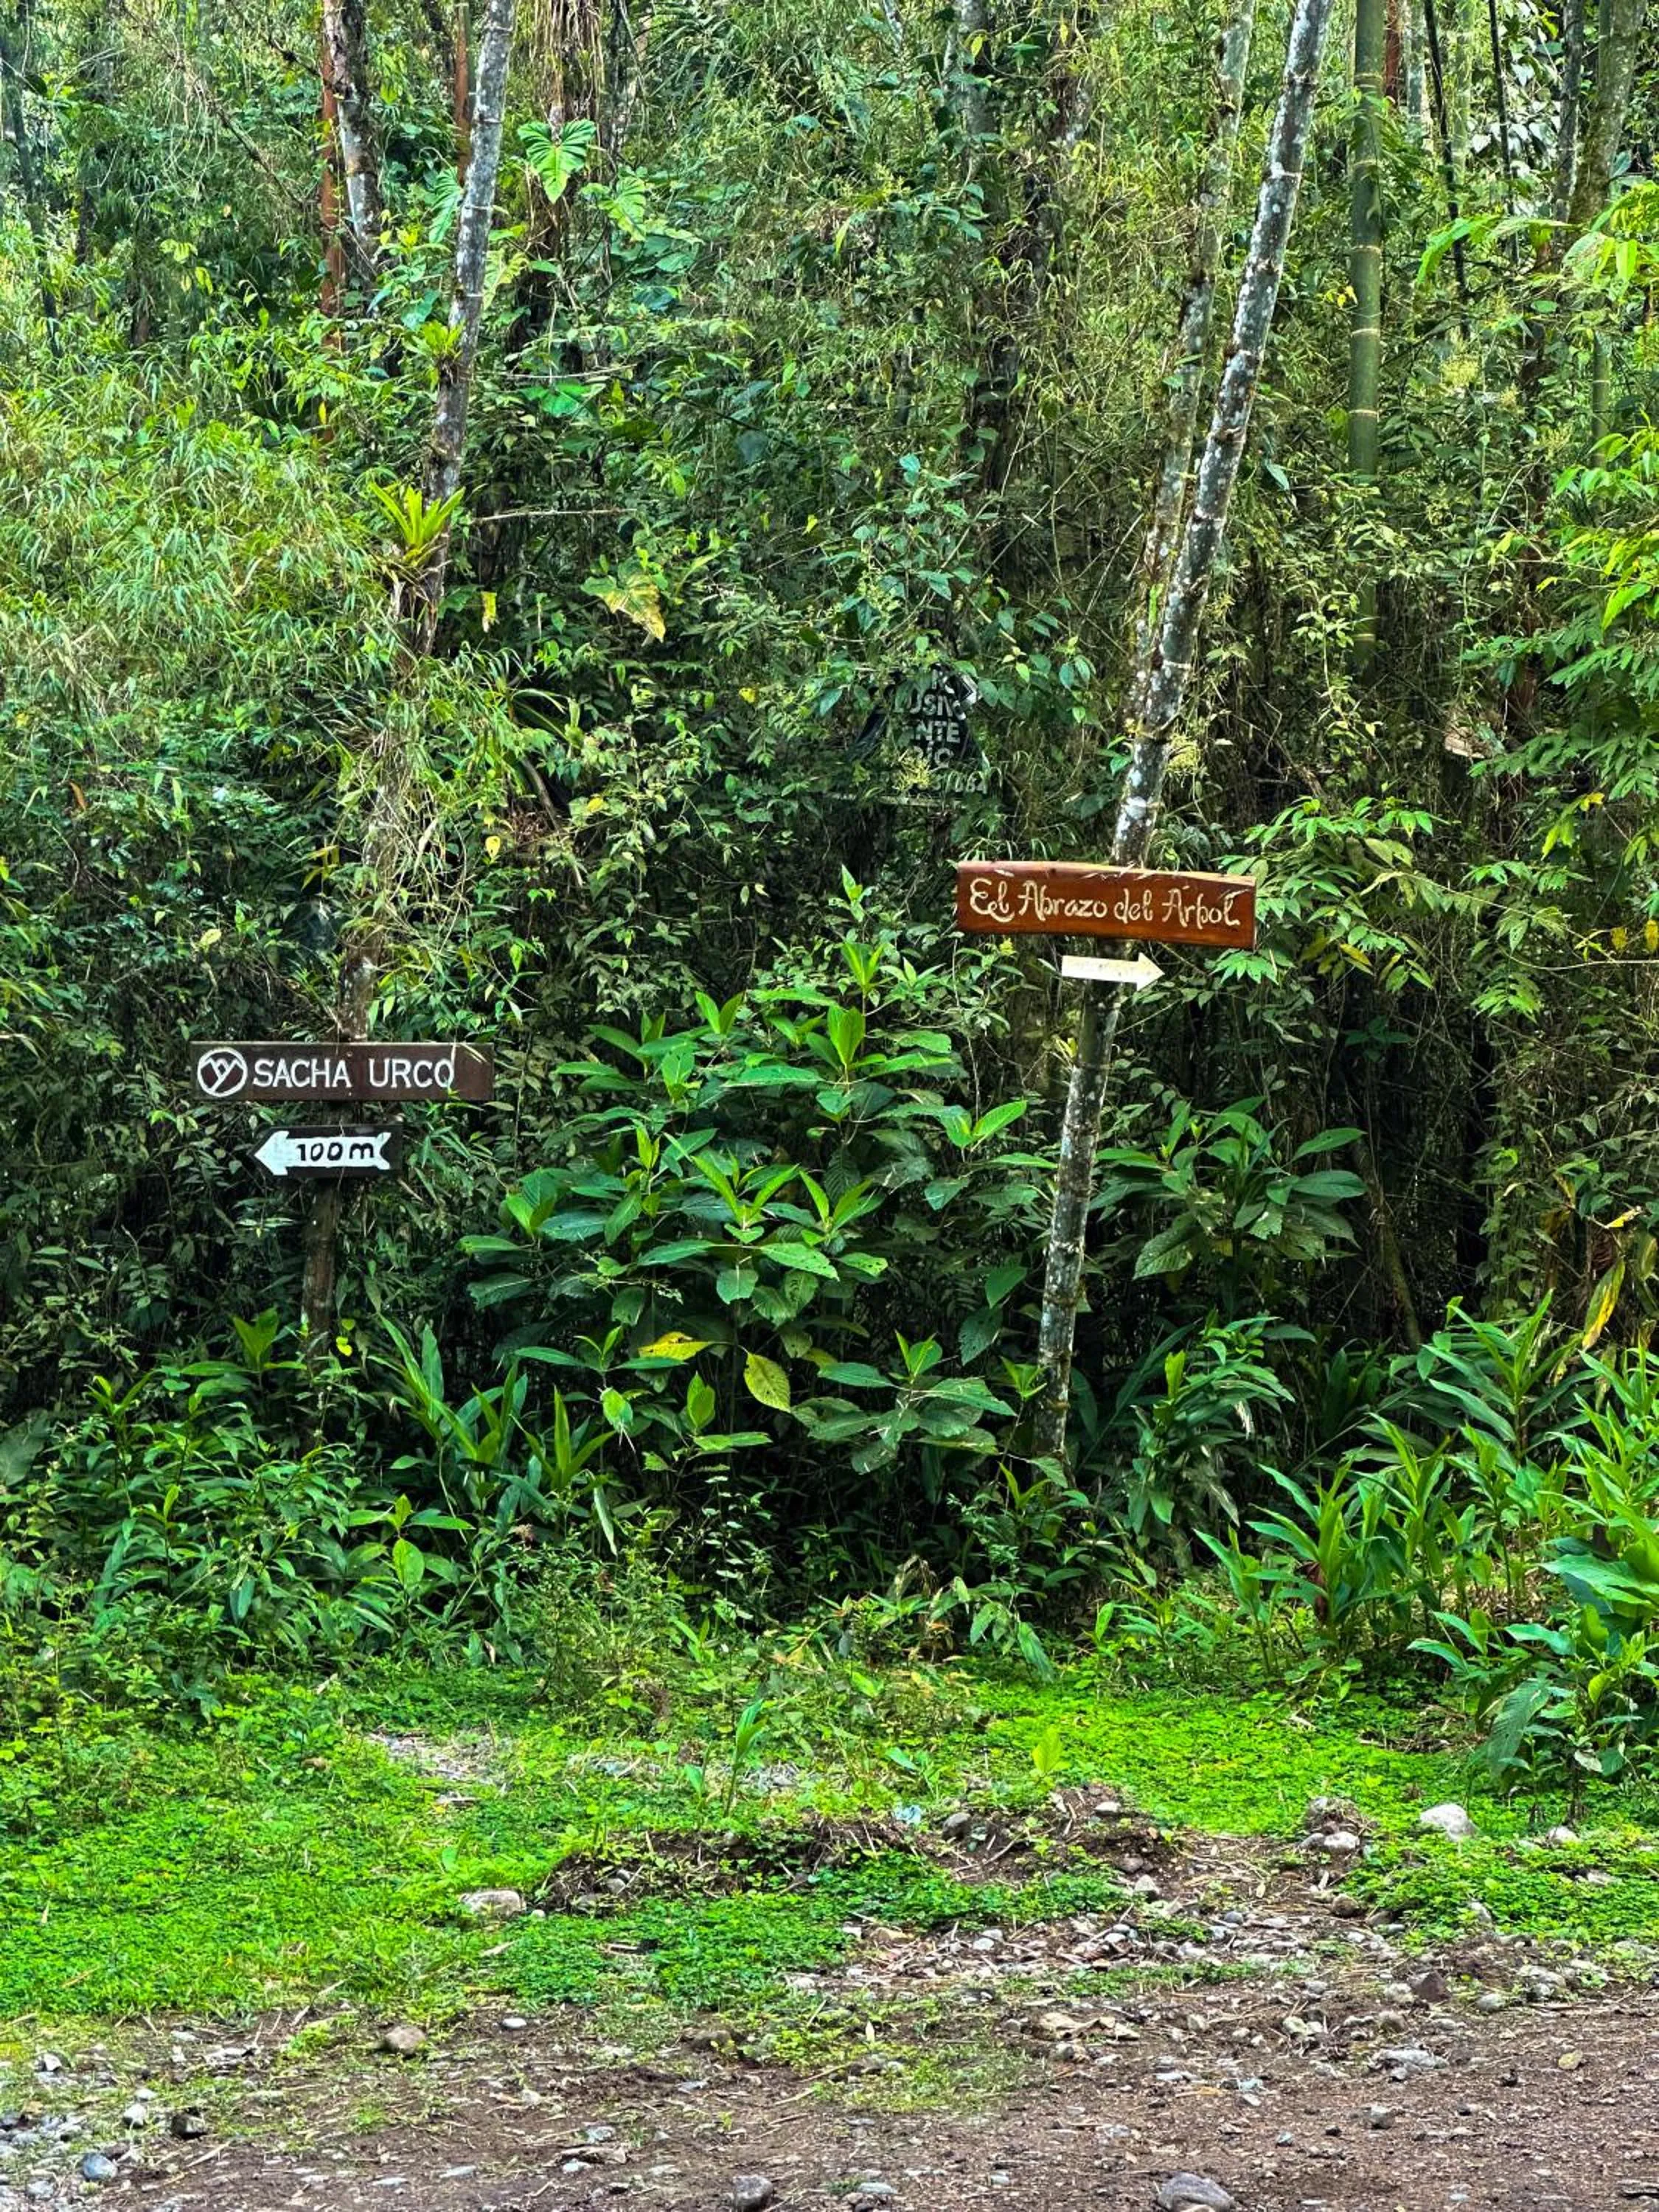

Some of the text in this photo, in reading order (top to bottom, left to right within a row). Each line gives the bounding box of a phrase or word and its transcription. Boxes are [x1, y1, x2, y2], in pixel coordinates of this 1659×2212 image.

[969, 877, 1015, 923] El
[1018, 880, 1107, 922] Abrazo
[1113, 888, 1154, 925] del
[253, 1058, 456, 1089] SACHA URCO
